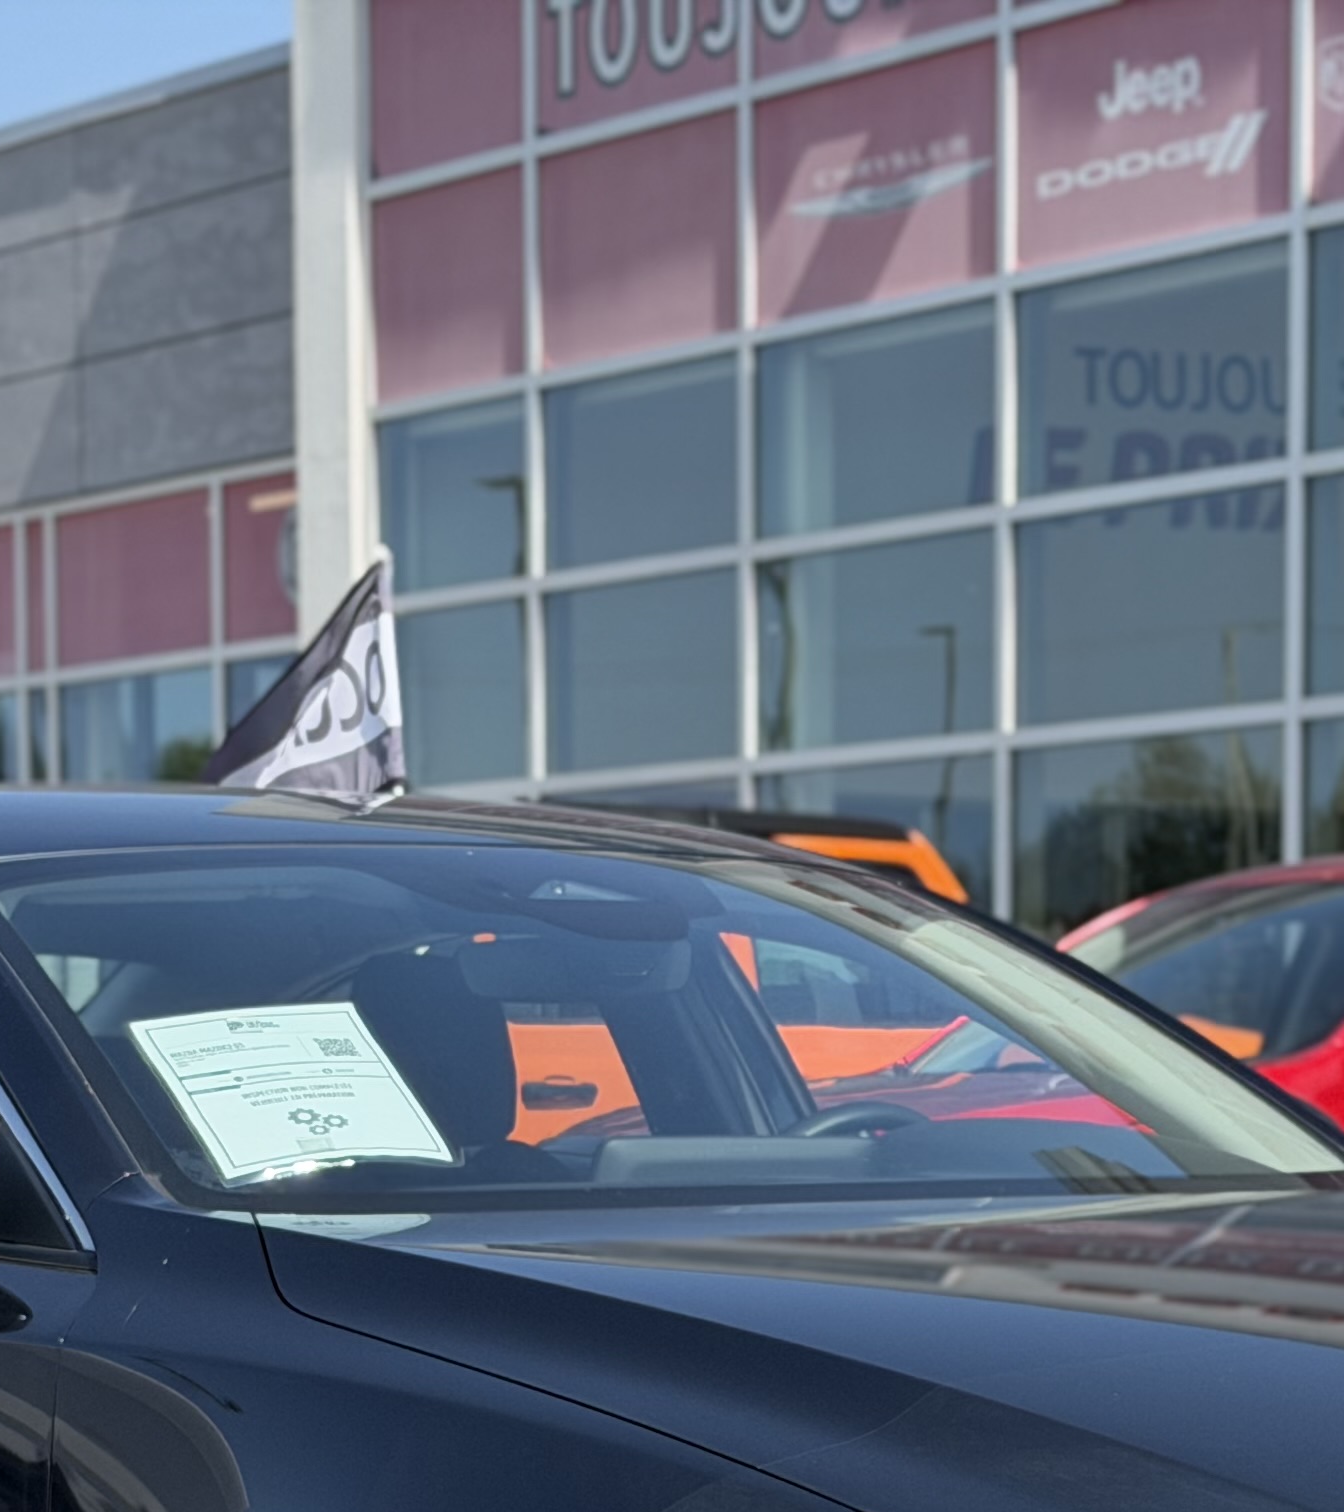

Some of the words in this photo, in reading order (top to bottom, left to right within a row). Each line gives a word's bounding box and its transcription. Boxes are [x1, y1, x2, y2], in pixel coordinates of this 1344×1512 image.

[545, 0, 902, 98] TOUJ
[1096, 56, 1203, 120] Jeep
[1035, 129, 1231, 201] DODGE
